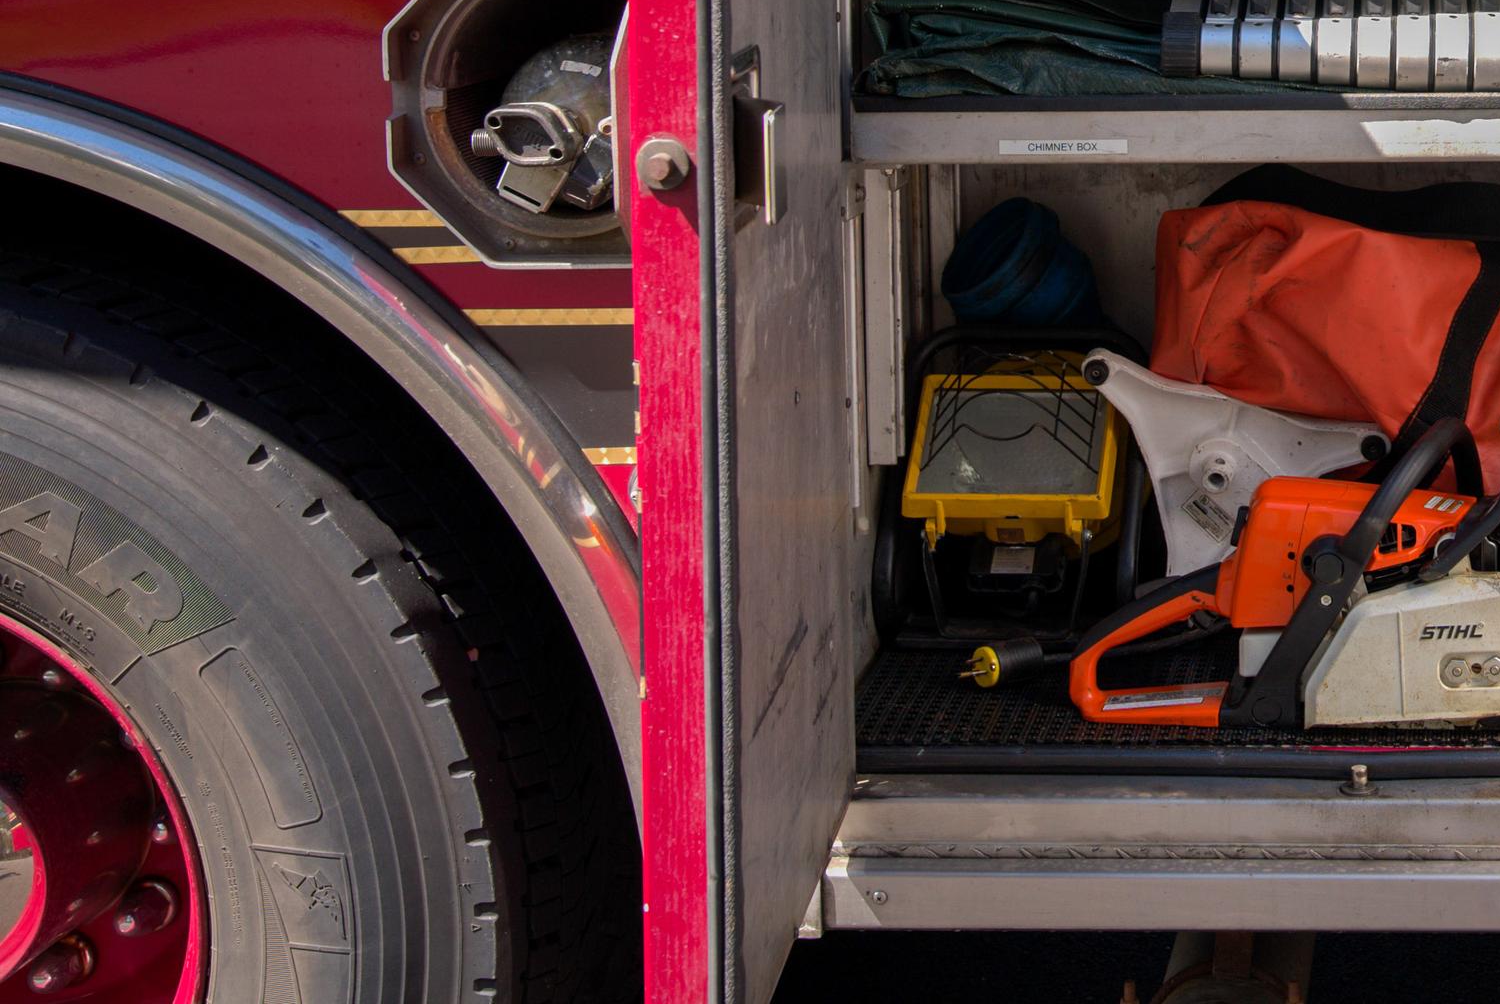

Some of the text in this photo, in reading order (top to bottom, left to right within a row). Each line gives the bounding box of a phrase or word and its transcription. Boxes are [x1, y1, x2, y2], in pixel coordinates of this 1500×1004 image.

[1028, 142, 1098, 153] CHIMNEY BOX
[1420, 624, 1482, 641] STIHL
